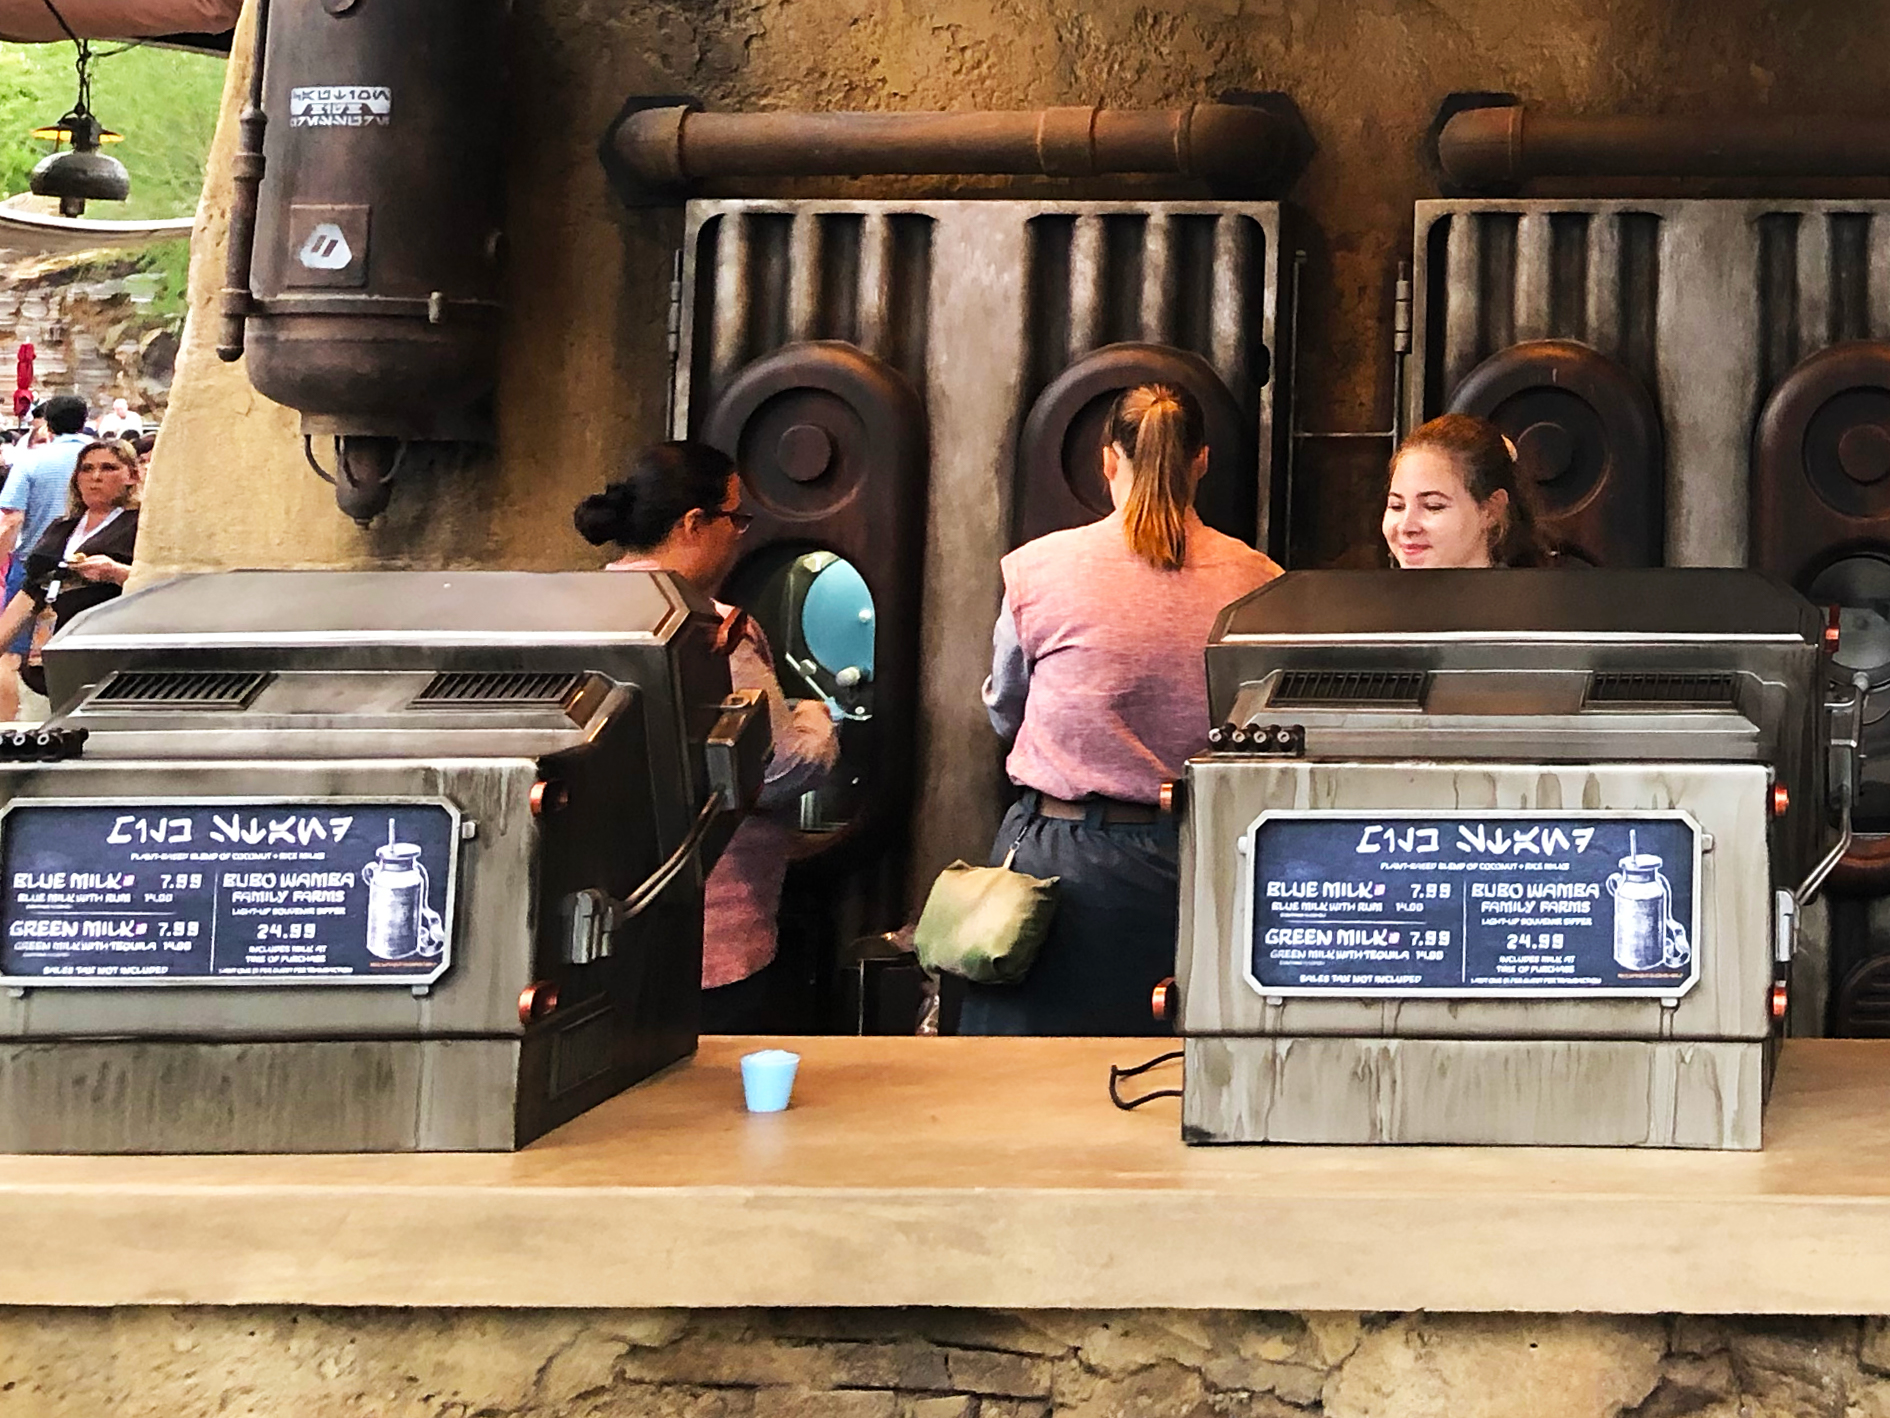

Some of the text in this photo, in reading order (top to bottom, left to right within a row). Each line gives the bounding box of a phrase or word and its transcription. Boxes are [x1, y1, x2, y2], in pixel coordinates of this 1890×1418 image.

[13, 872, 202, 890] BLUE MILK 7.99
[223, 873, 355, 888] BUBO WAMBA
[232, 890, 345, 903] FAMILY FARMS
[1266, 881, 1451, 898] BLUE MILK 7.99
[1472, 883, 1599, 898] BUBO WAMBA
[17, 893, 45, 902] BLUE
[48, 893, 75, 902] MILK
[76, 893, 103, 902] WITH
[1271, 902, 1299, 911] BLUE
[1301, 902, 1328, 911] MILK
[1329, 902, 1356, 911] WITH
[1481, 901, 1590, 913] FAMILY FARMS
[10, 920, 199, 937] GREEN MILK 7.99
[257, 924, 316, 939] 24.99
[1265, 929, 1450, 946] GREEN MILK 7.99
[1507, 934, 1564, 949] 24.99
[14, 941, 50, 951] GREEN
[53, 942, 81, 951] MILK
[82, 942, 109, 951] WITH
[1270, 949, 1306, 959] GREEN
[1308, 949, 1335, 959] MILK
[1336, 950, 1363, 959] WITH
[98, 966, 118, 974] NOT
[1352, 975, 1372, 983] NOT
